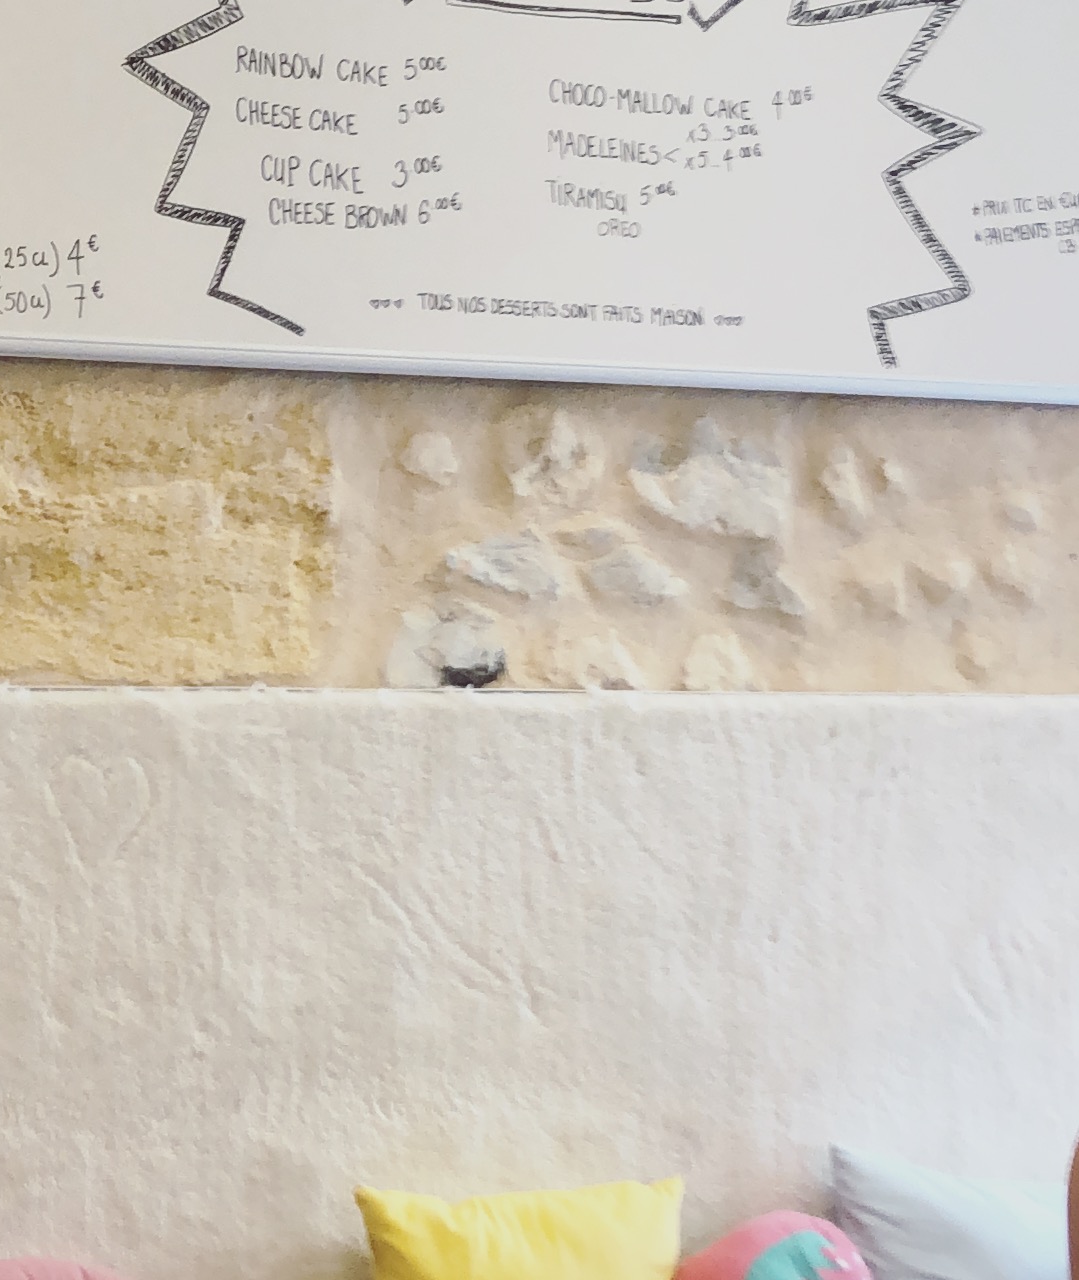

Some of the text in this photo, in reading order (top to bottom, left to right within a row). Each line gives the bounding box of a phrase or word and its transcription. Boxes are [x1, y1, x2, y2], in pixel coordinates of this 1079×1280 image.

[235, 44, 390, 87] RAINBOW CAKE
[235, 96, 359, 136] CHEESE CAKE
[260, 154, 364, 194] CUP CAKE
